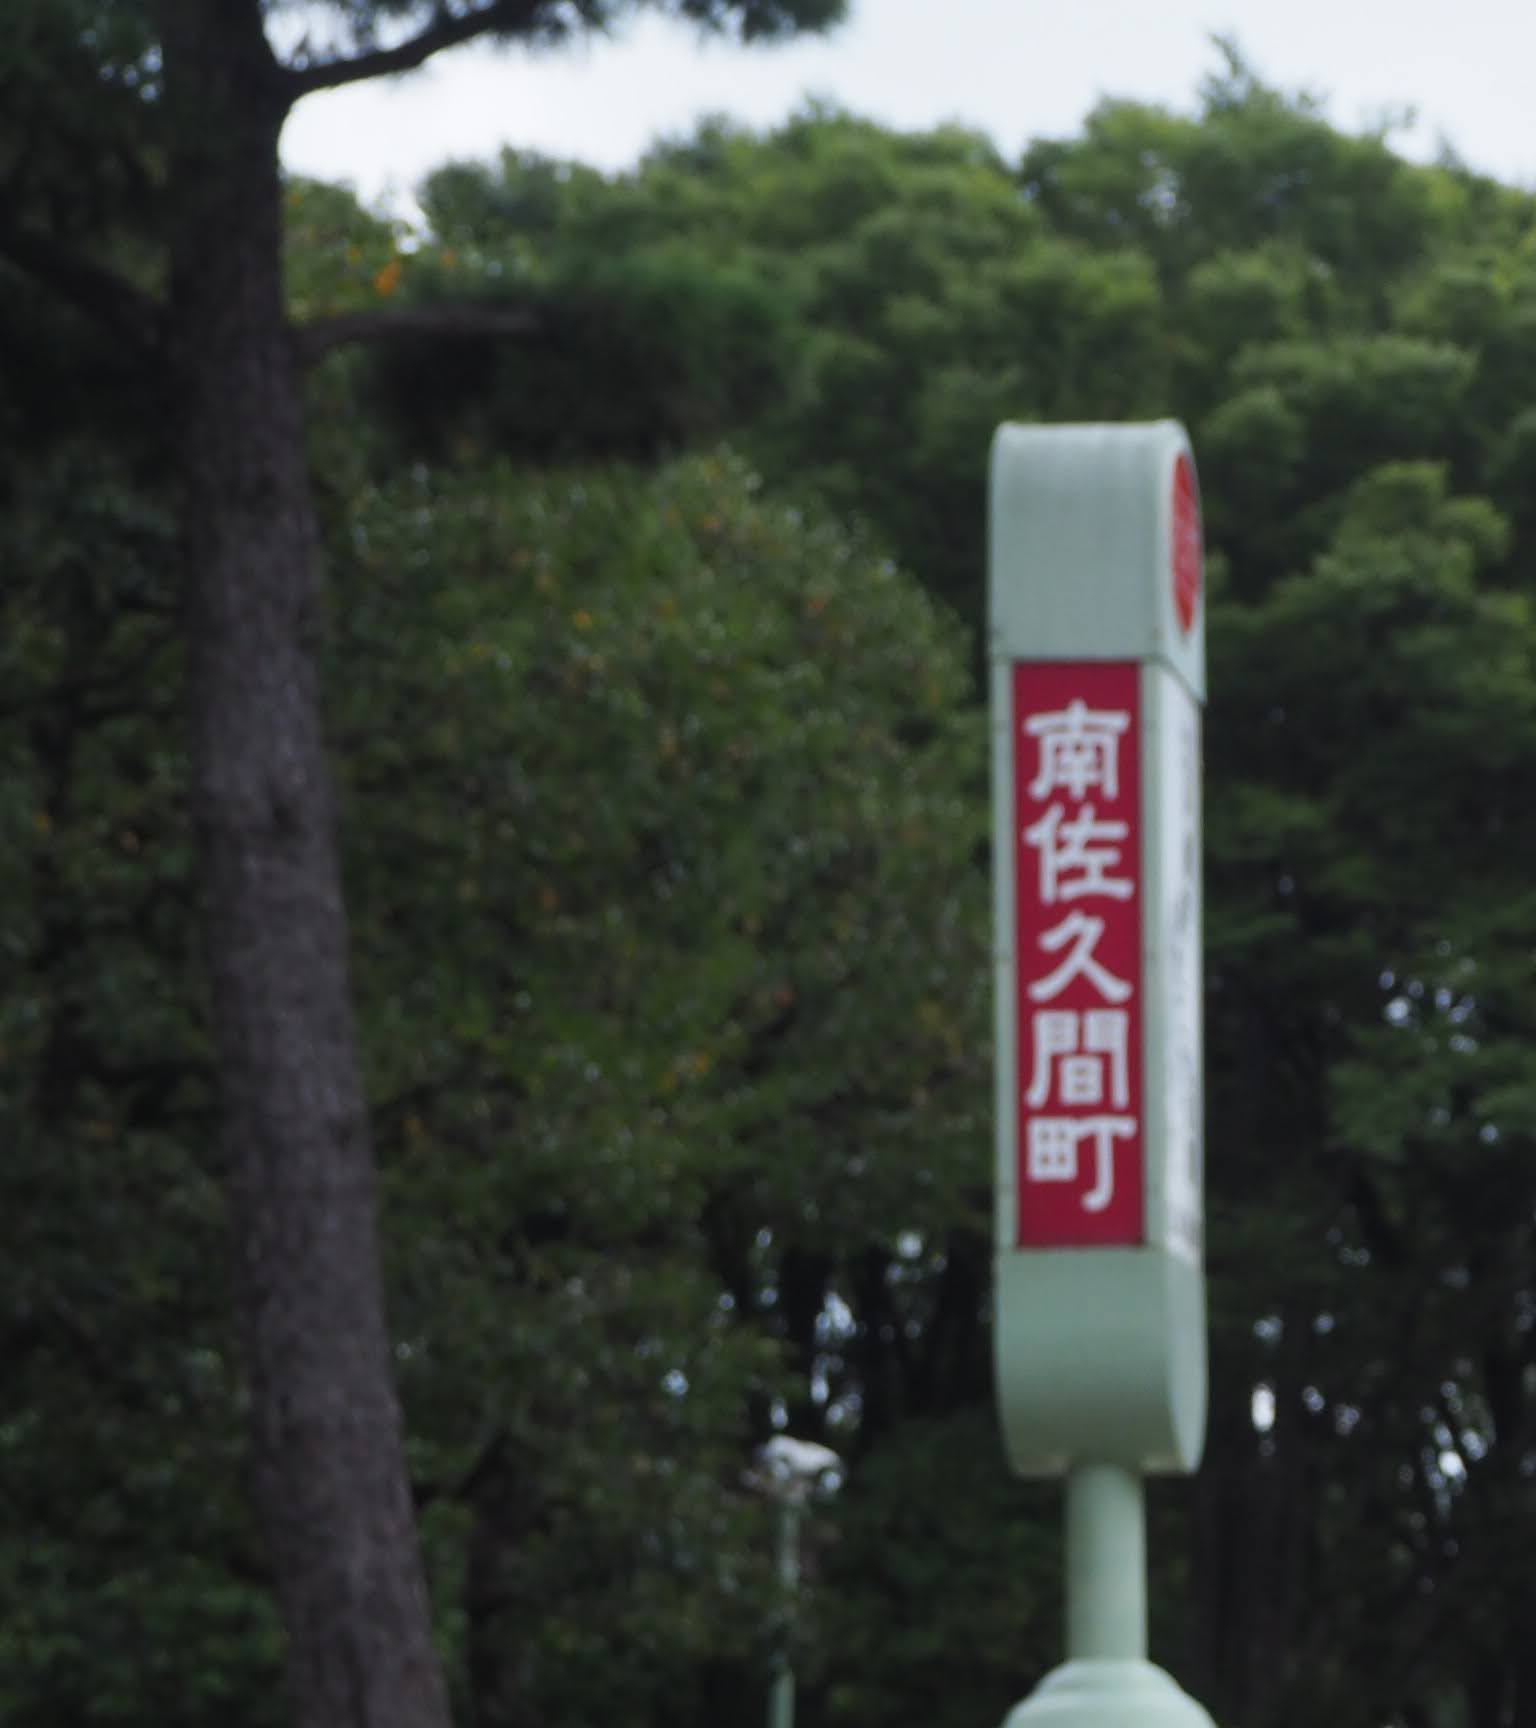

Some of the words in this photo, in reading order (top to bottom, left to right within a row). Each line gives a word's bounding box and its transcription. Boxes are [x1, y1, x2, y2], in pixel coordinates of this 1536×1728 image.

[1024, 699, 1137, 1211] 南佐久間町
